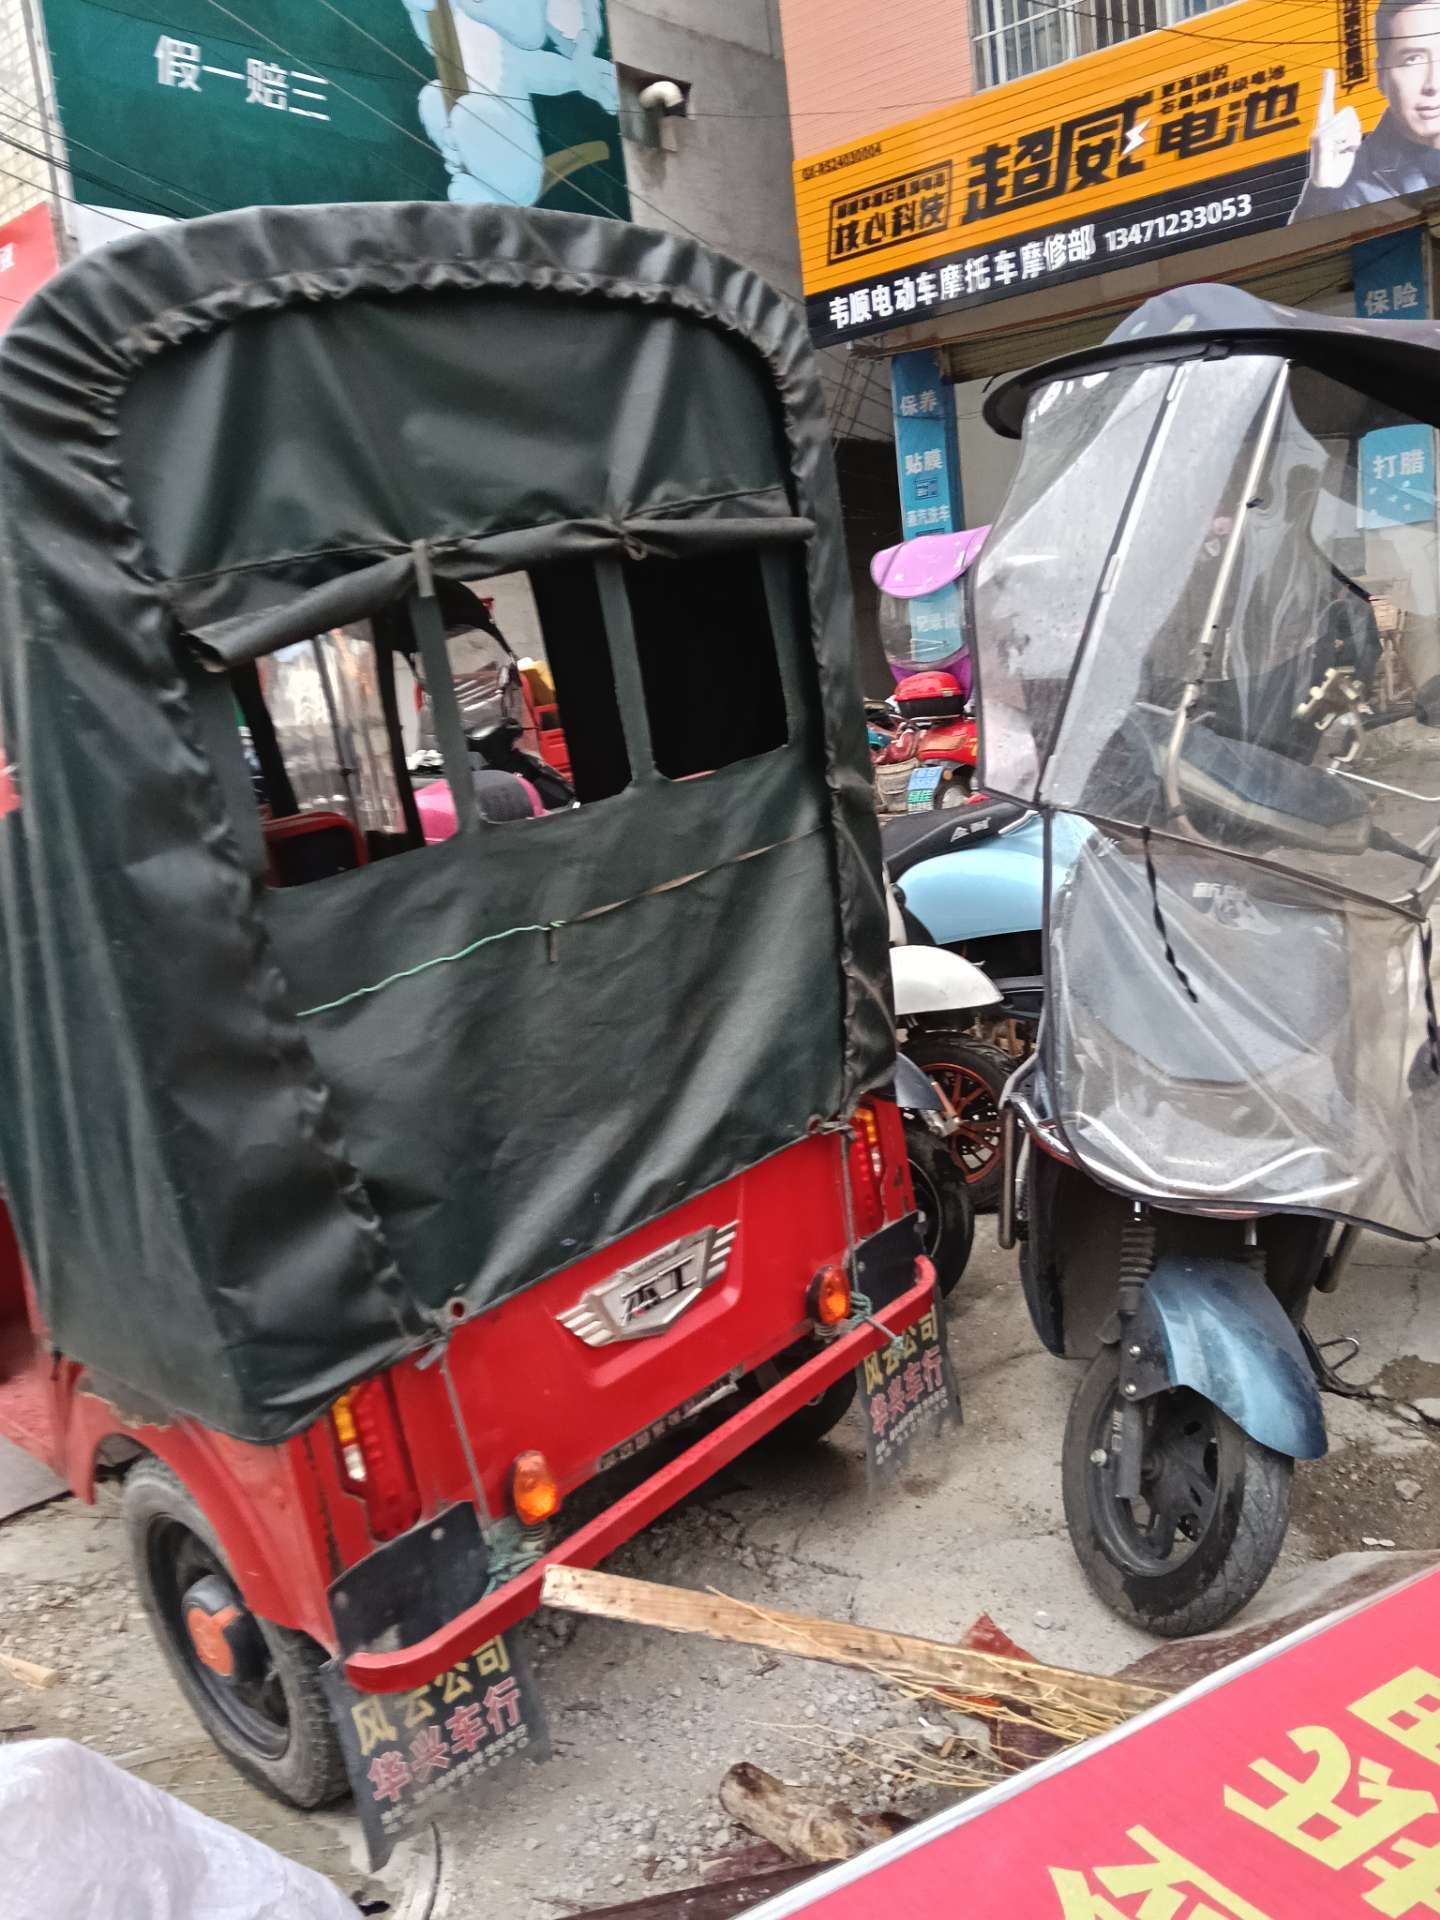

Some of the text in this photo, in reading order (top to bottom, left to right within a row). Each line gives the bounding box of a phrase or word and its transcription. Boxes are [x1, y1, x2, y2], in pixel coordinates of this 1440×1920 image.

[154, 35, 330, 120] 假一赔三
[834, 193, 945, 255] 核心科技
[1105, 193, 1253, 253] 13471233053
[1364, 282, 1418, 317] 保险
[900, 389, 938, 416] 保养
[904, 448, 944, 475] 贴膜
[367, 1677, 523, 1804] 华兴车行
